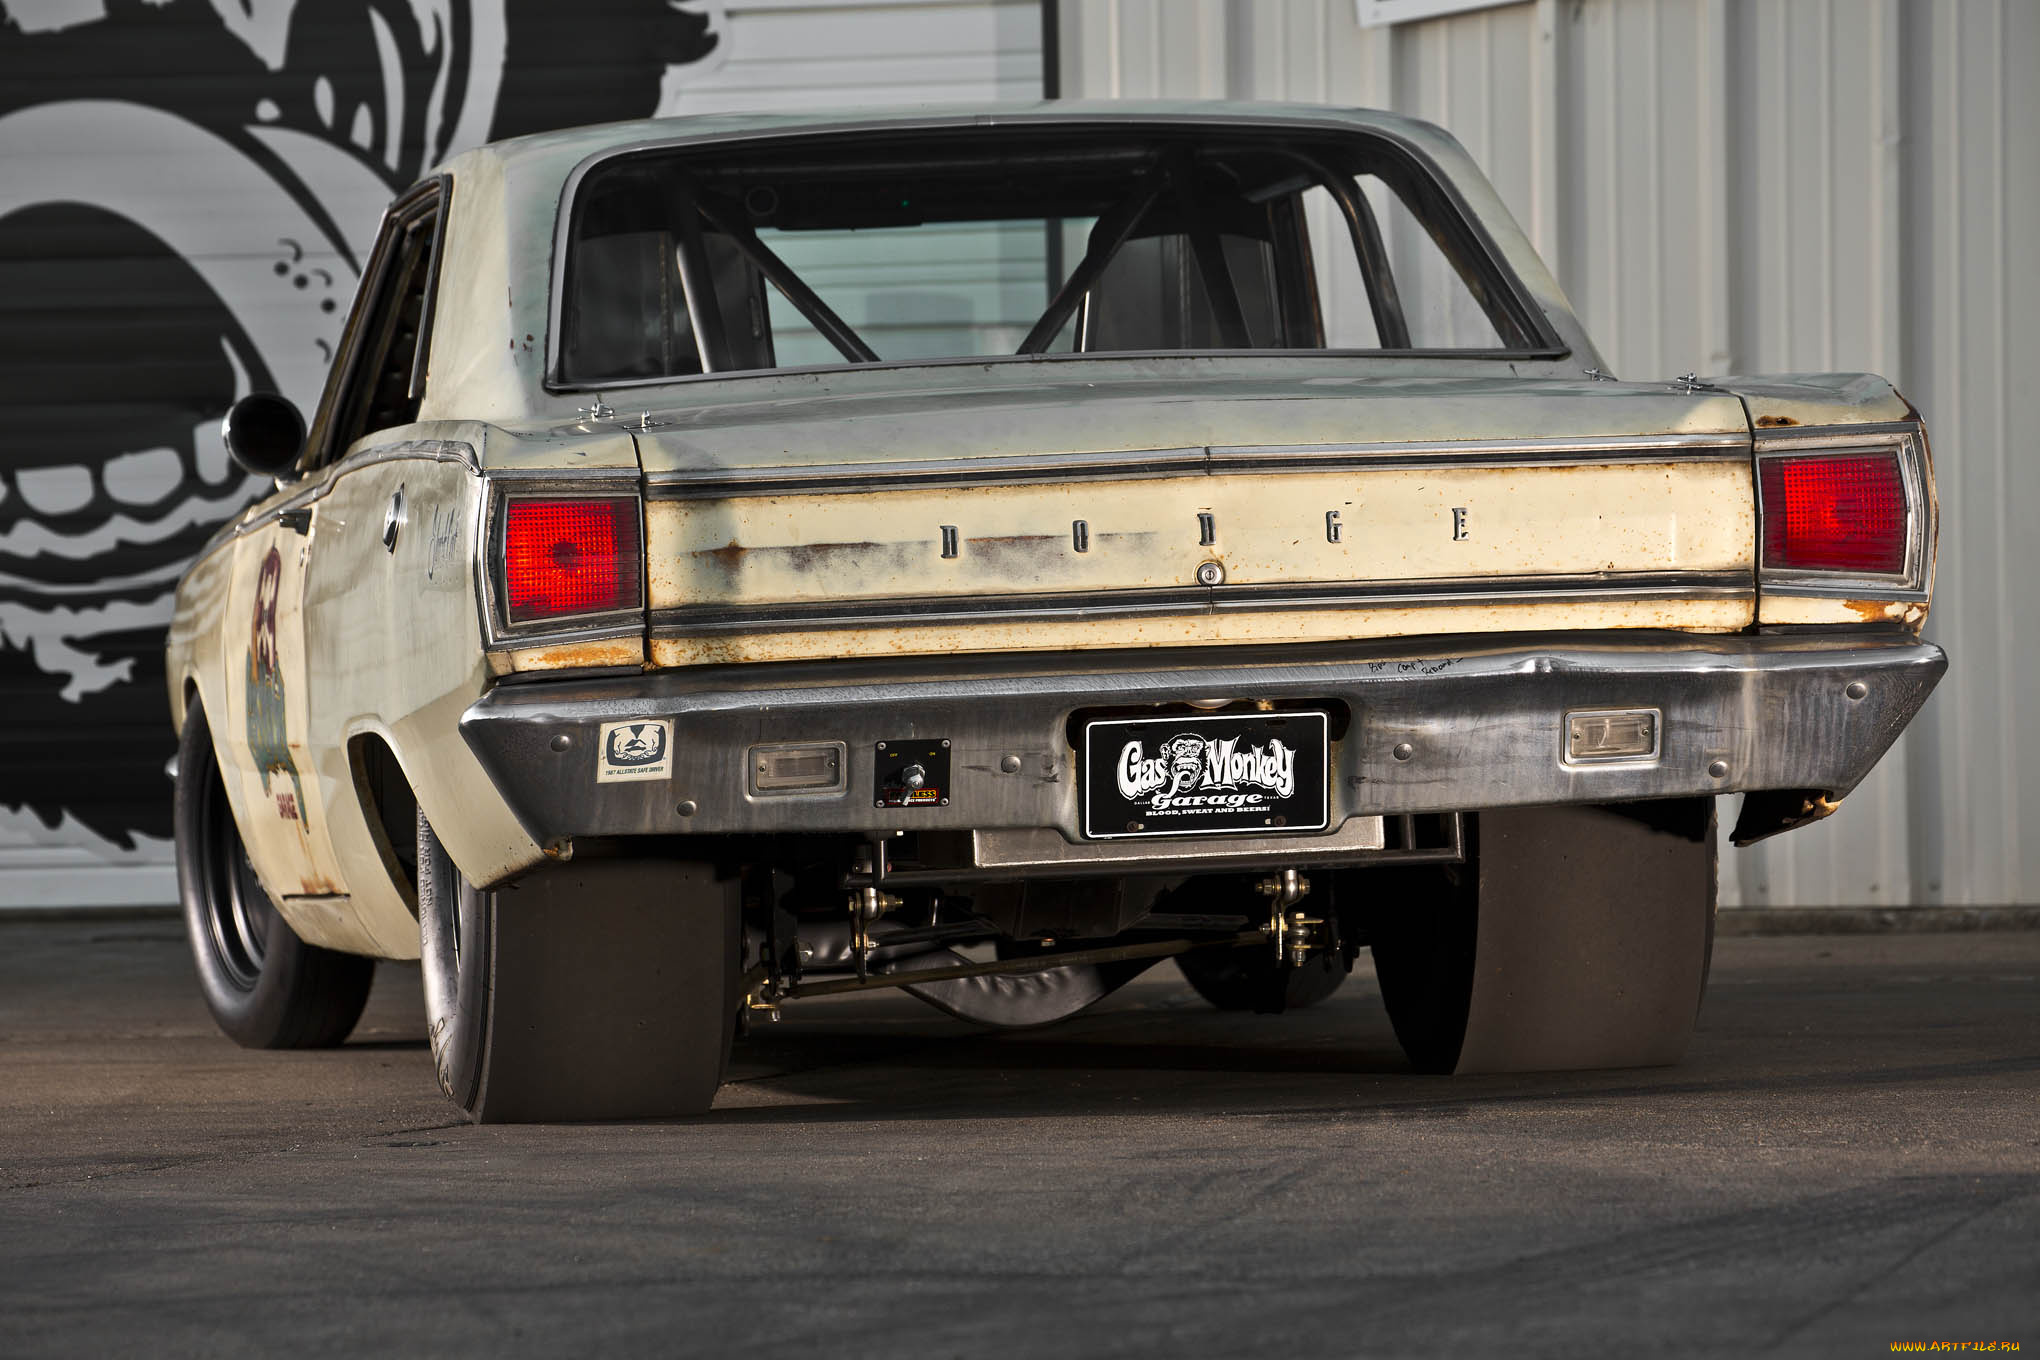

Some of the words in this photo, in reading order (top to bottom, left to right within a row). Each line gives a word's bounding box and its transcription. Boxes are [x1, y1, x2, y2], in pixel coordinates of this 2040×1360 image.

[939, 507, 1469, 560] DODGE
[1117, 741, 1168, 800] Gas
[1200, 734, 1296, 799] Monkey
[1145, 809, 1181, 817] BLOOD,
[1151, 793, 1263, 810] Garage
